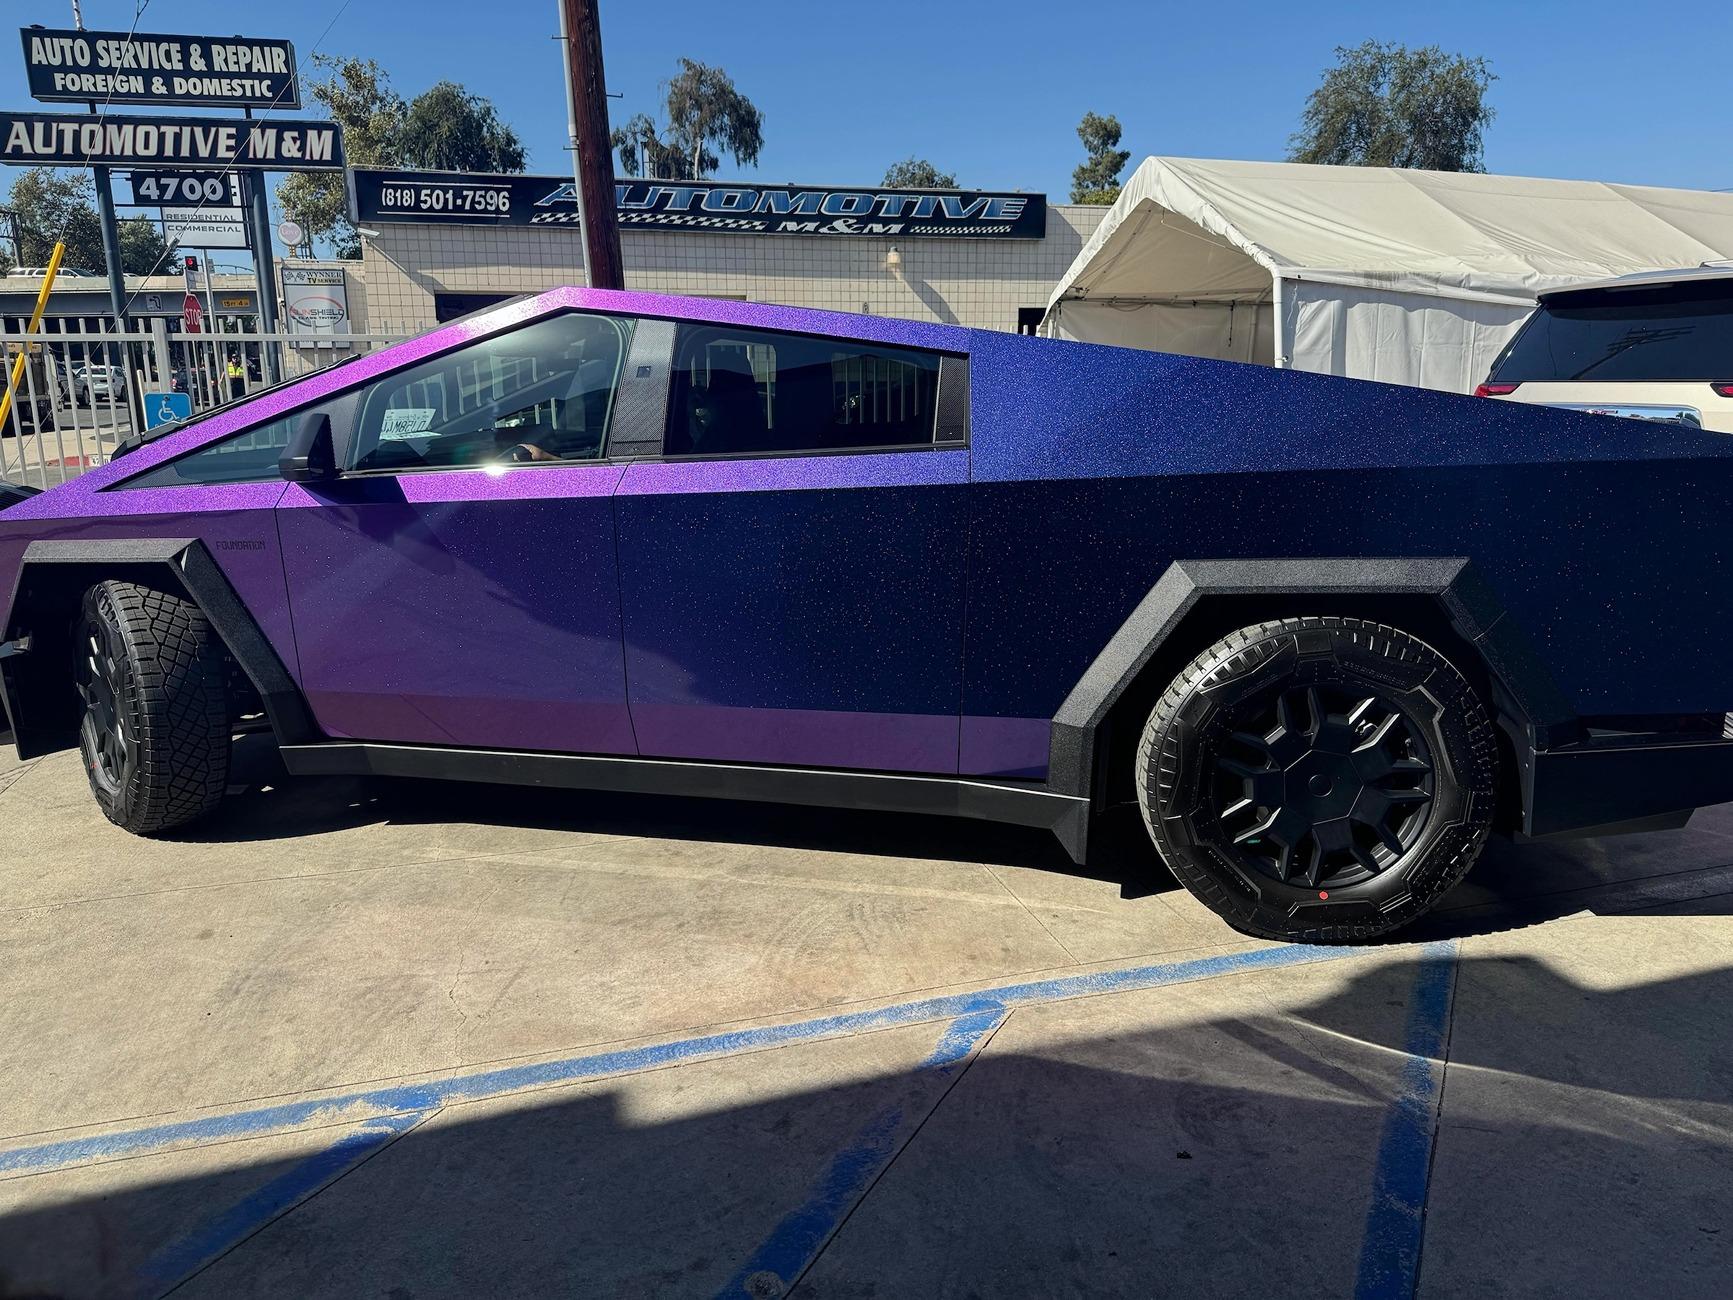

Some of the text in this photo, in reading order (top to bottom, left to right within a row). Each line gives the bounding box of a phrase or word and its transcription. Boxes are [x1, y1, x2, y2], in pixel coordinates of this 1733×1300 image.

[31, 37, 288, 74] AUTO SERVICE & REPAIR
[54, 72, 273, 98] FOREIGN & DOMESTIC
[5, 121, 334, 161] AUTOMOTIVE M&M
[139, 177, 224, 201] 4700
[381, 188, 510, 212] (818) 501-7596
[533, 183, 1028, 220] AUTOMOTIVE
[166, 213, 237, 222] RESIDENTIAL
[167, 224, 242, 233] COMMERCIAL
[775, 218, 905, 234] M&M
[185, 309, 201, 325] STOP
[216, 541, 266, 550] FOUNDATION
